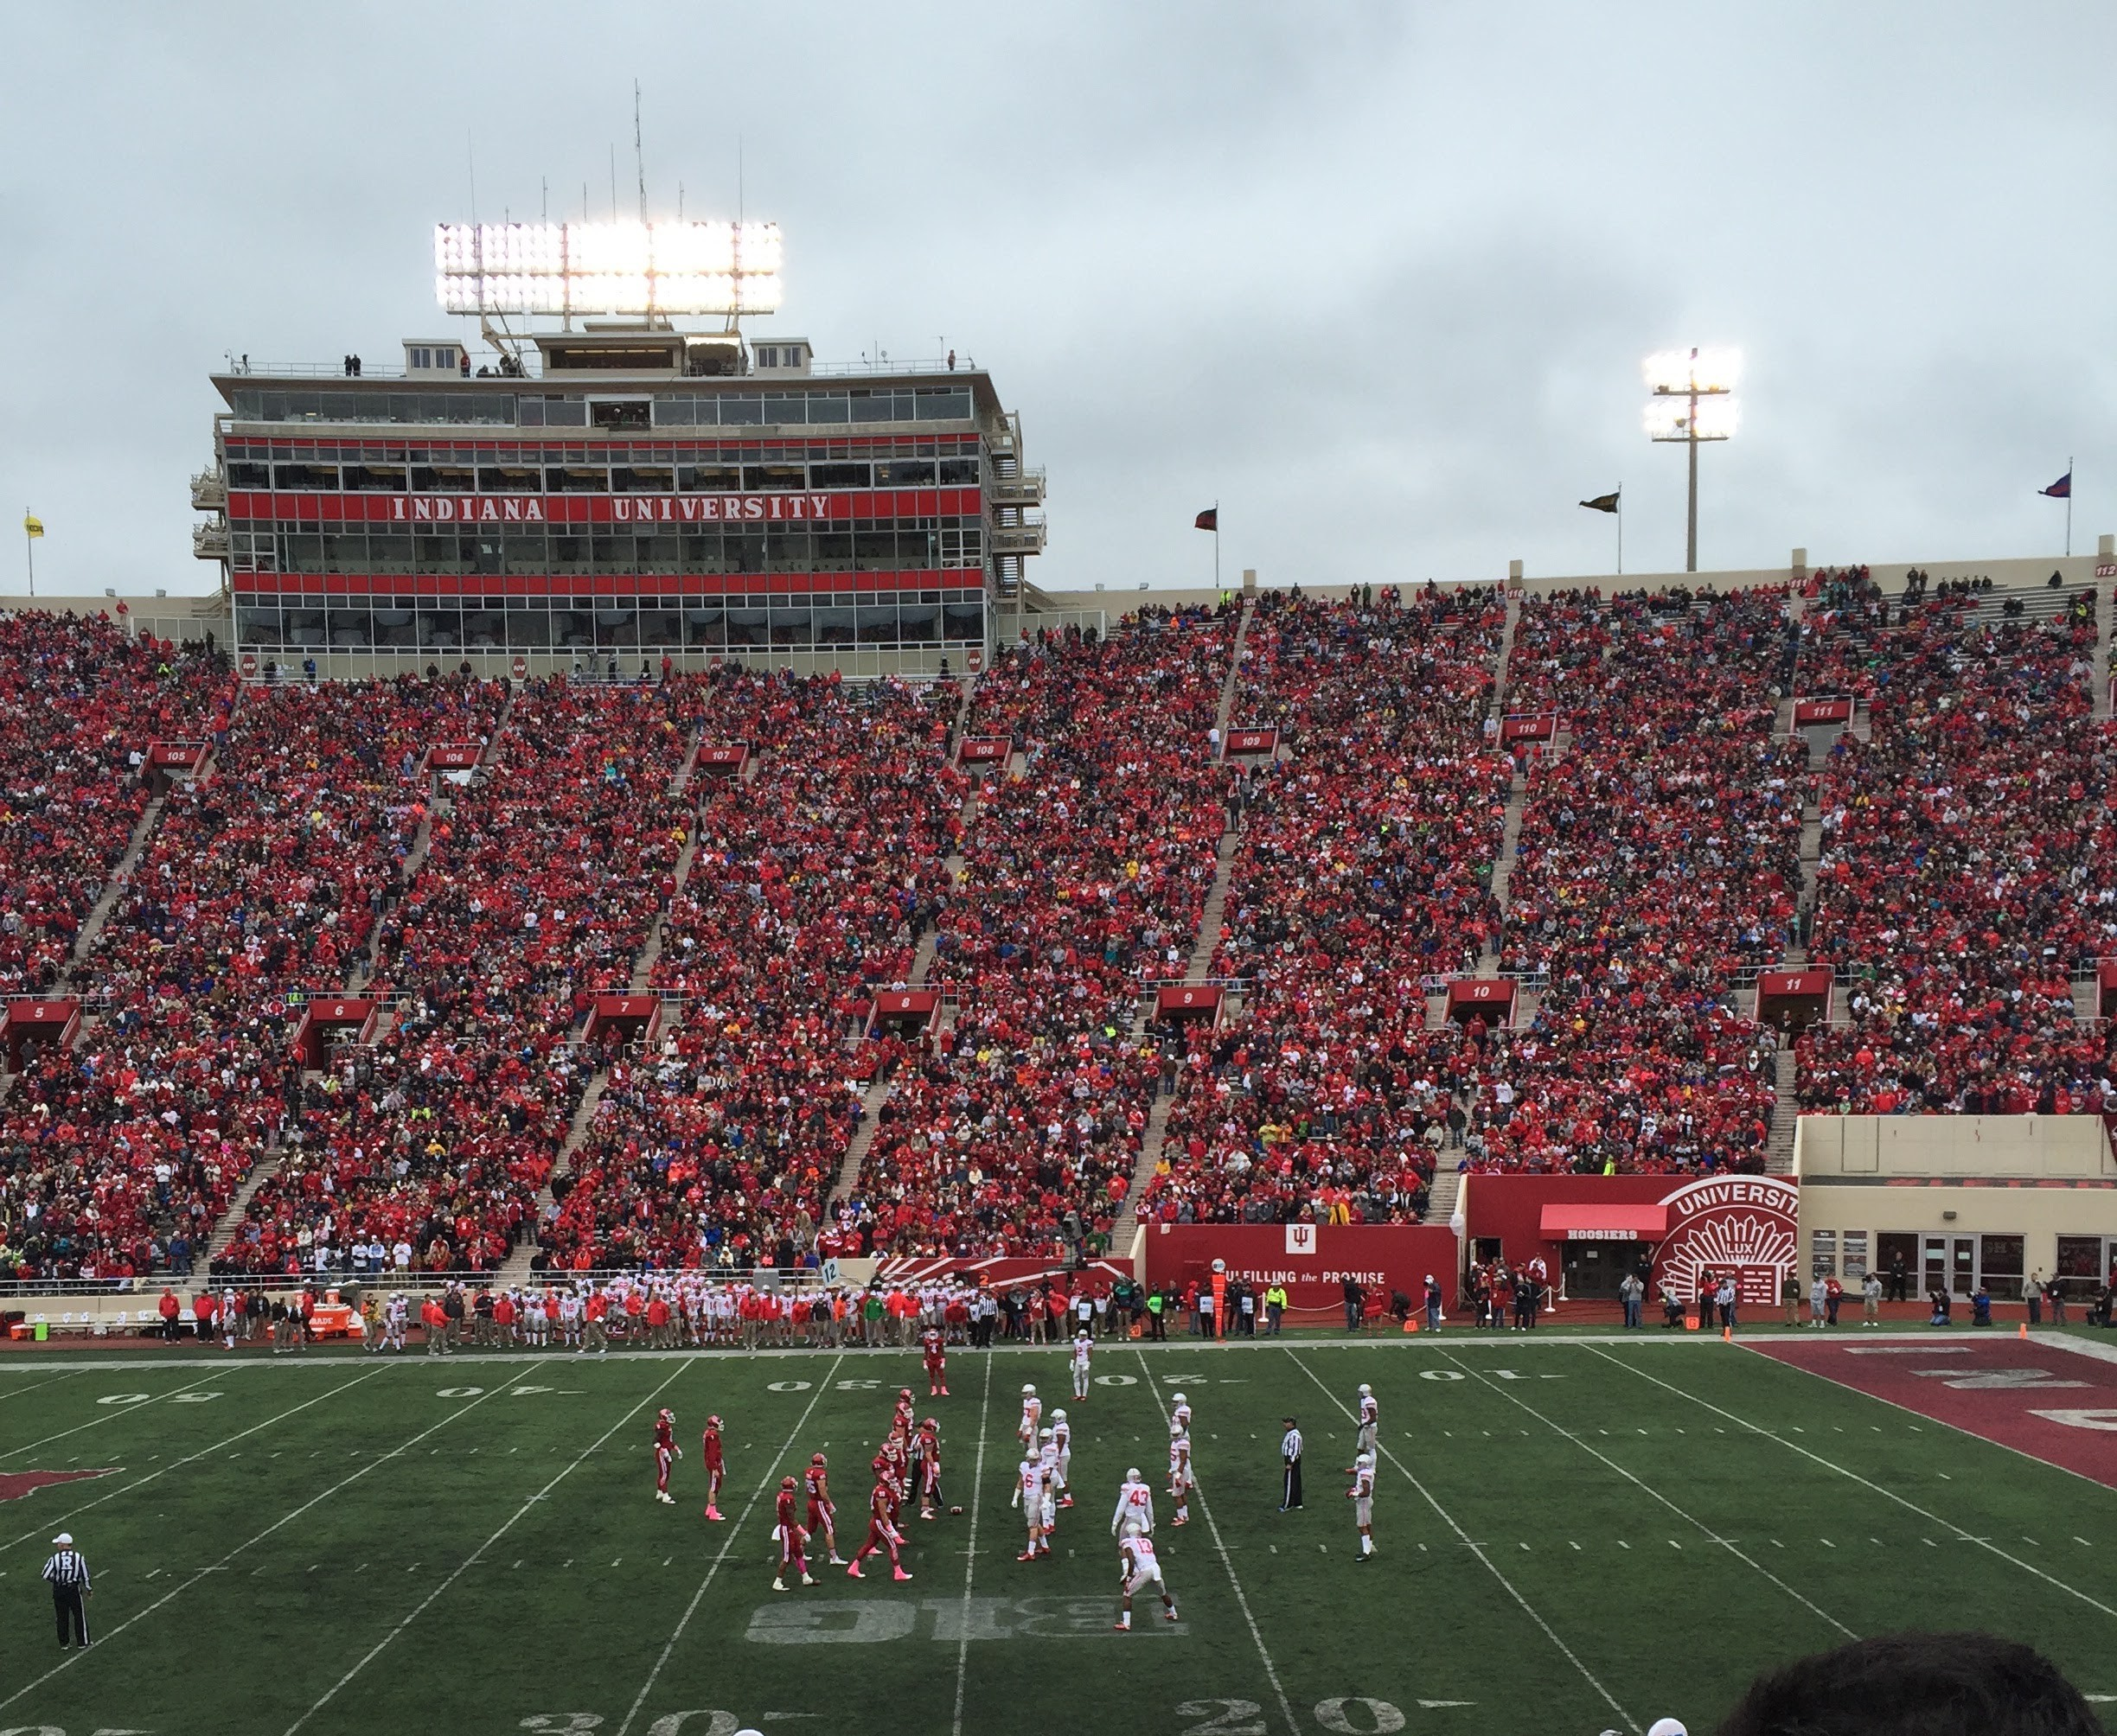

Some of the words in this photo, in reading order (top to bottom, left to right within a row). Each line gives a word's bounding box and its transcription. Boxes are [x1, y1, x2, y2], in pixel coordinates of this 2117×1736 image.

[393, 498, 544, 520] INDIANA
[613, 496, 828, 520] UNIVERSITY
[2096, 565, 2116, 576] 112
[1790, 578, 1807, 589] 111
[1508, 589, 1524, 598] 110
[1813, 706, 1832, 717] 111
[1519, 724, 1537, 734] 110
[1243, 737, 1261, 746] 109
[713, 750, 731, 760] 107
[976, 744, 995, 755] 108
[167, 751, 186, 761] 105
[445, 752, 464, 762] 106
[1787, 979, 1801, 991] 11
[1184, 992, 1193, 1004] 9
[1473, 986, 1490, 998] 10
[621, 1001, 630, 1012] 7
[901, 997, 911, 1008] 8
[35, 1007, 44, 1018] 5
[335, 1005, 344, 1016] 6
[1677, 1184, 1798, 1217] UNIVERSIT
[1567, 1229, 1638, 1241] HOOSIERS
[1726, 1242, 1753, 1254] LUX
[824, 1263, 836, 1283] 12
[1220, 1270, 1296, 1283] UFILLING
[1301, 1273, 1318, 1282] the
[980, 1274, 989, 1286] 2
[1026, 1474, 1033, 1488] 6
[1129, 1490, 1148, 1506] 43
[1137, 1539, 1153, 1554] 13
[61, 1556, 73, 1570] R
[1175, 1697, 1405, 1735] 20
